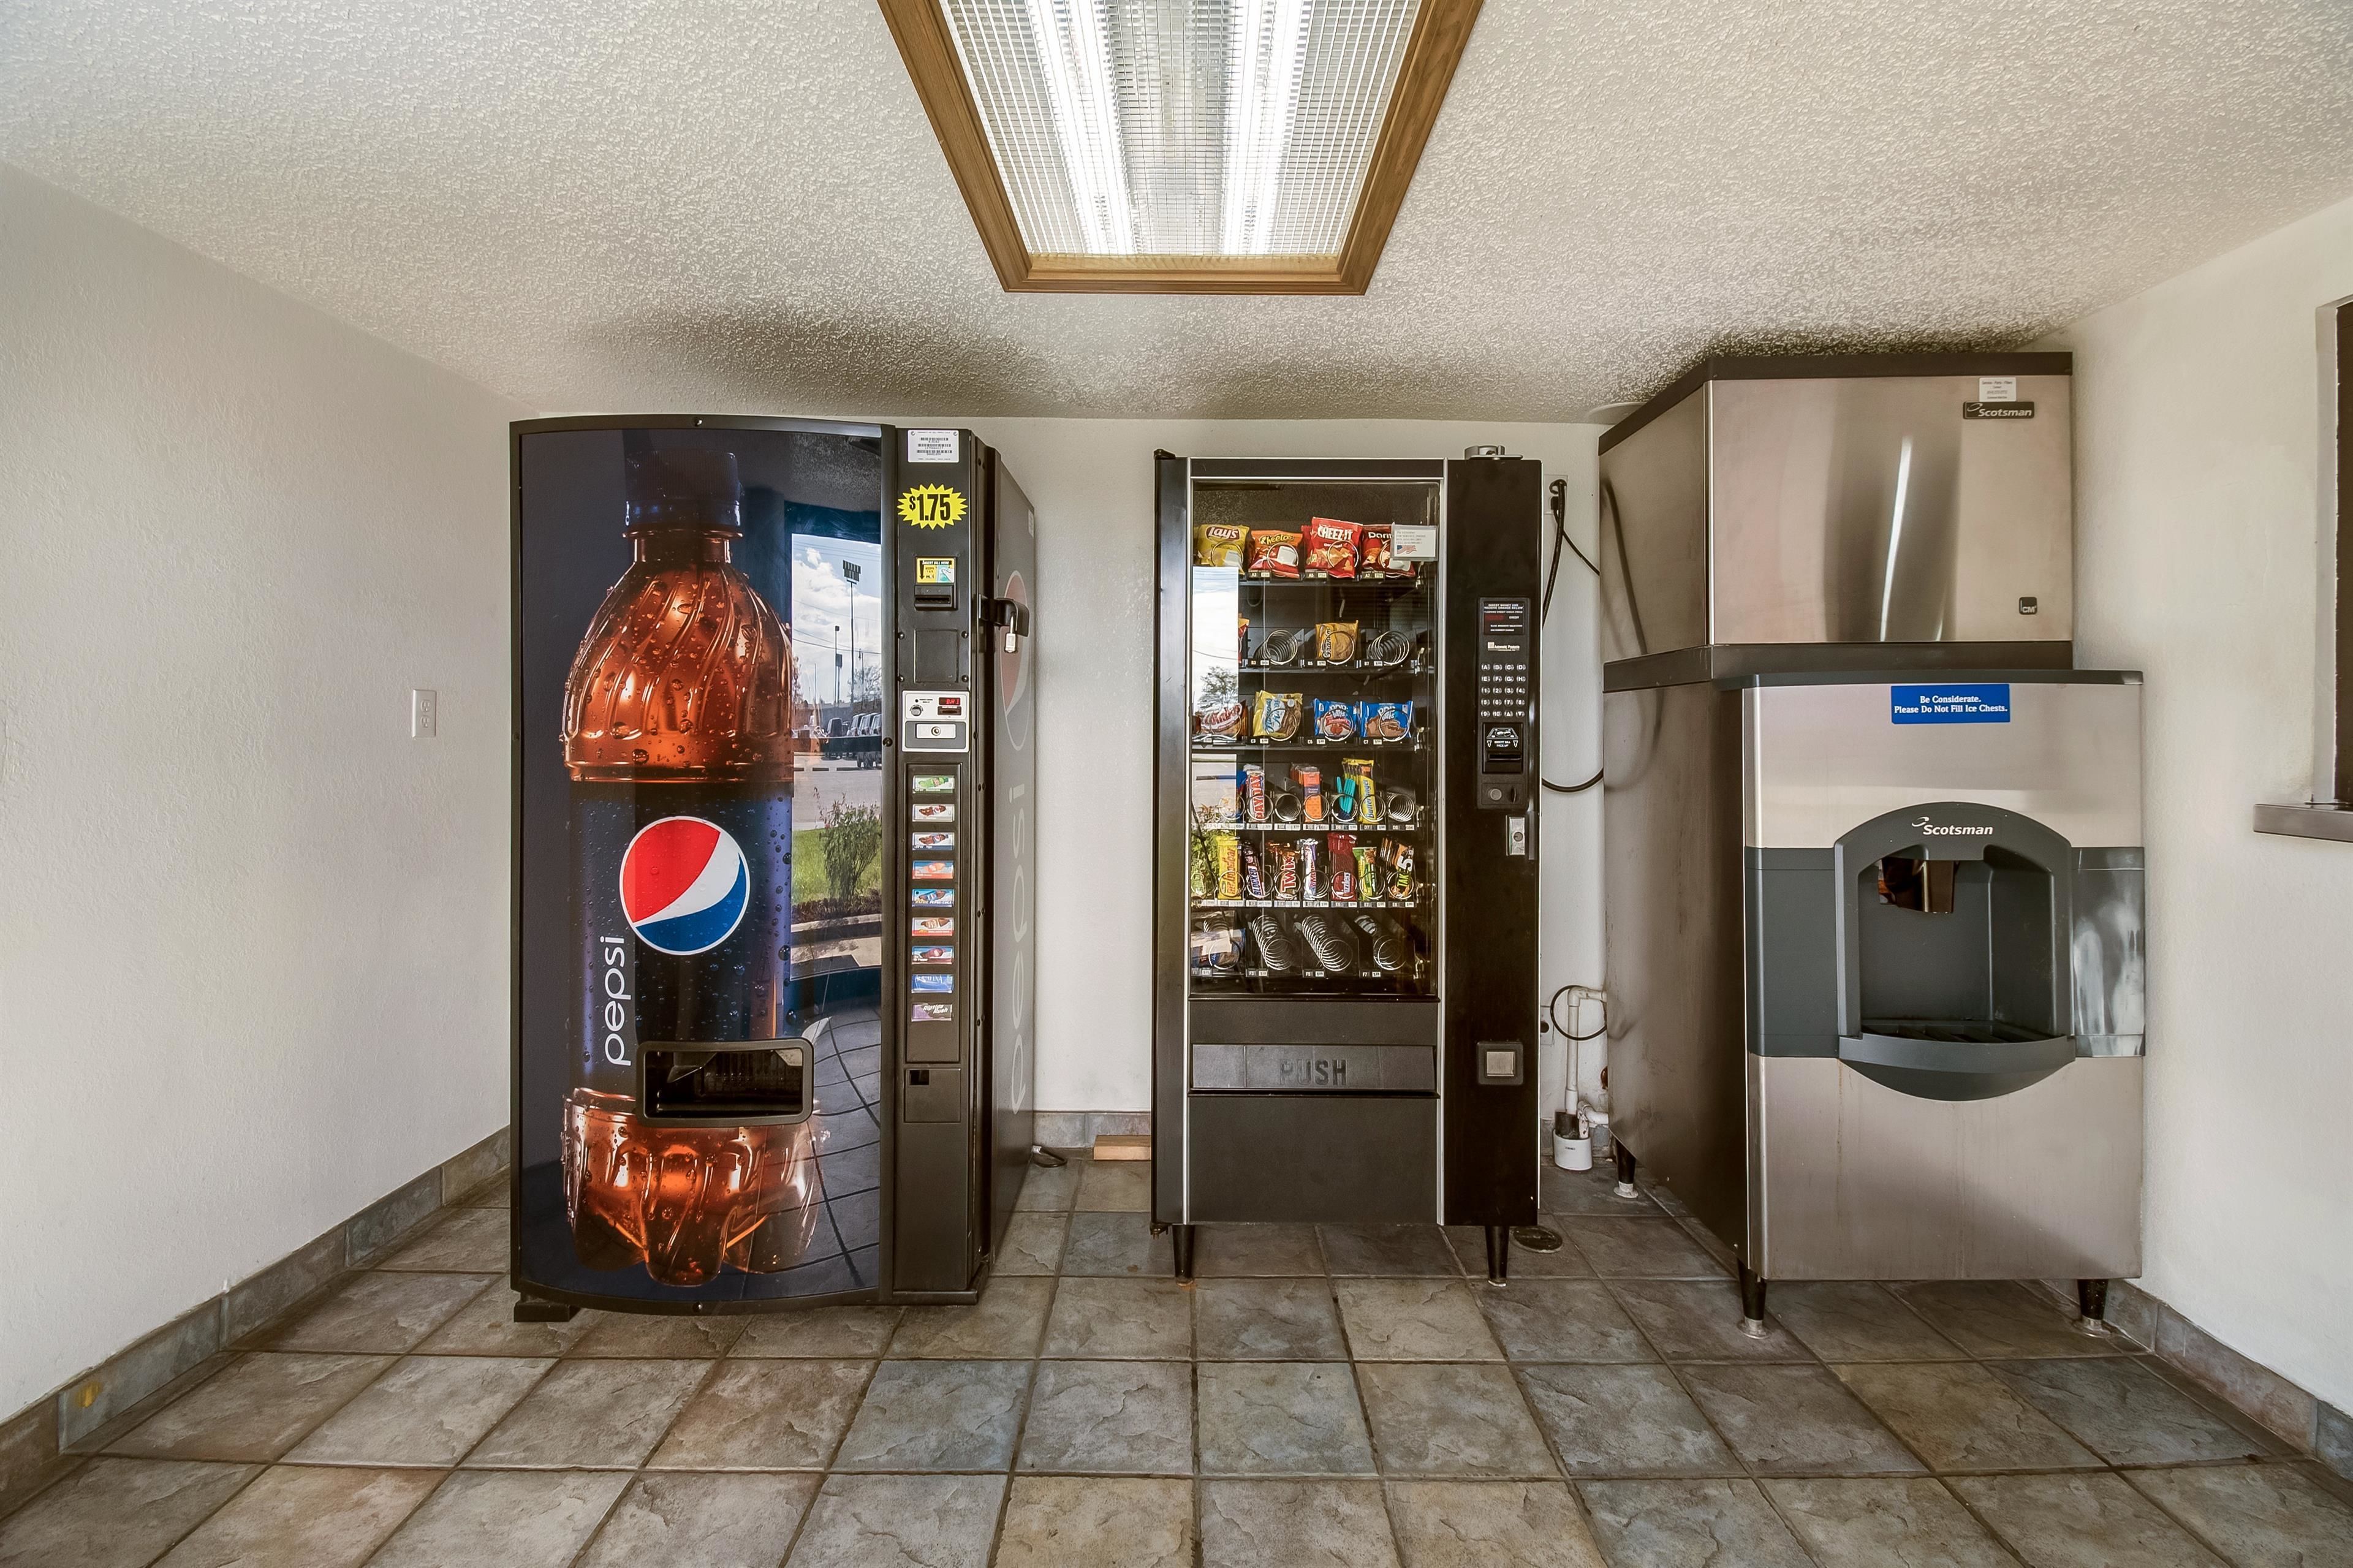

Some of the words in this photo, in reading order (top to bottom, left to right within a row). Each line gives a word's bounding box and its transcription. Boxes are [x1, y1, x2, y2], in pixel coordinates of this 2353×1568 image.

[1978, 408, 2032, 417] Scotsman
[909, 493, 950, 521] $1.75
[1208, 526, 1238, 540] Lay's
[1260, 534, 1294, 545] Cheetos
[1931, 695, 1982, 703] Considerate.
[1250, 775, 1265, 819] PAYDAY
[1922, 824, 1993, 835] Scotsman
[1009, 783, 1028, 1115] pepsi
[600, 936, 631, 1066] pepsi
[1279, 1058, 1347, 1087] PUSH
